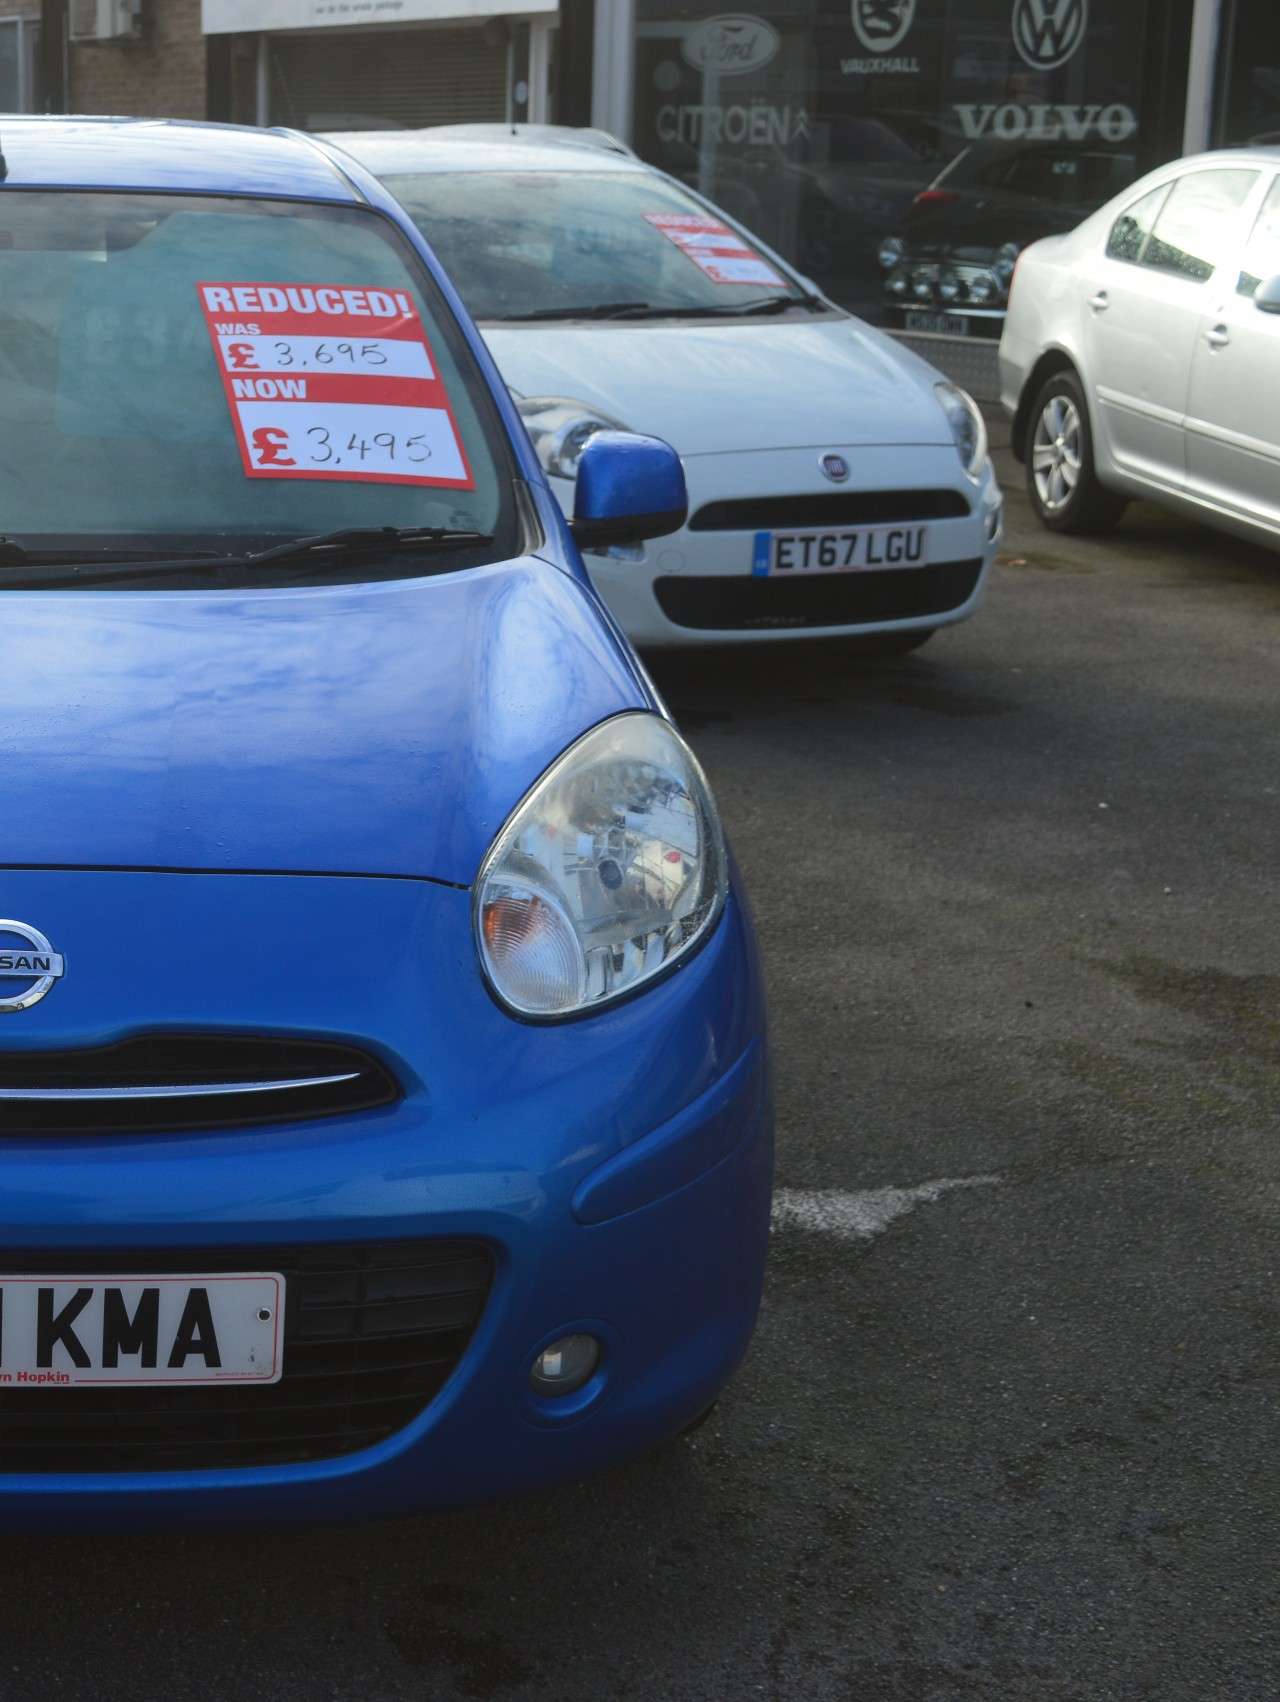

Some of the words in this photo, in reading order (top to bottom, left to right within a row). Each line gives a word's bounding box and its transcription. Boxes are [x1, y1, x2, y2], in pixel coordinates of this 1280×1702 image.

[840, 57, 919, 75] VAUXHALL
[953, 103, 1136, 142] VOLVO
[203, 286, 413, 319] REDUCED!
[215, 323, 261, 336] WAS
[228, 343, 260, 369] £
[231, 379, 306, 399] NOW
[252, 427, 297, 466] £
[775, 534, 858, 569] ET67
[866, 528, 926, 564] LGU
[36, 1287, 222, 1369] KMA
[17, 1371, 70, 1384] Hopkin
